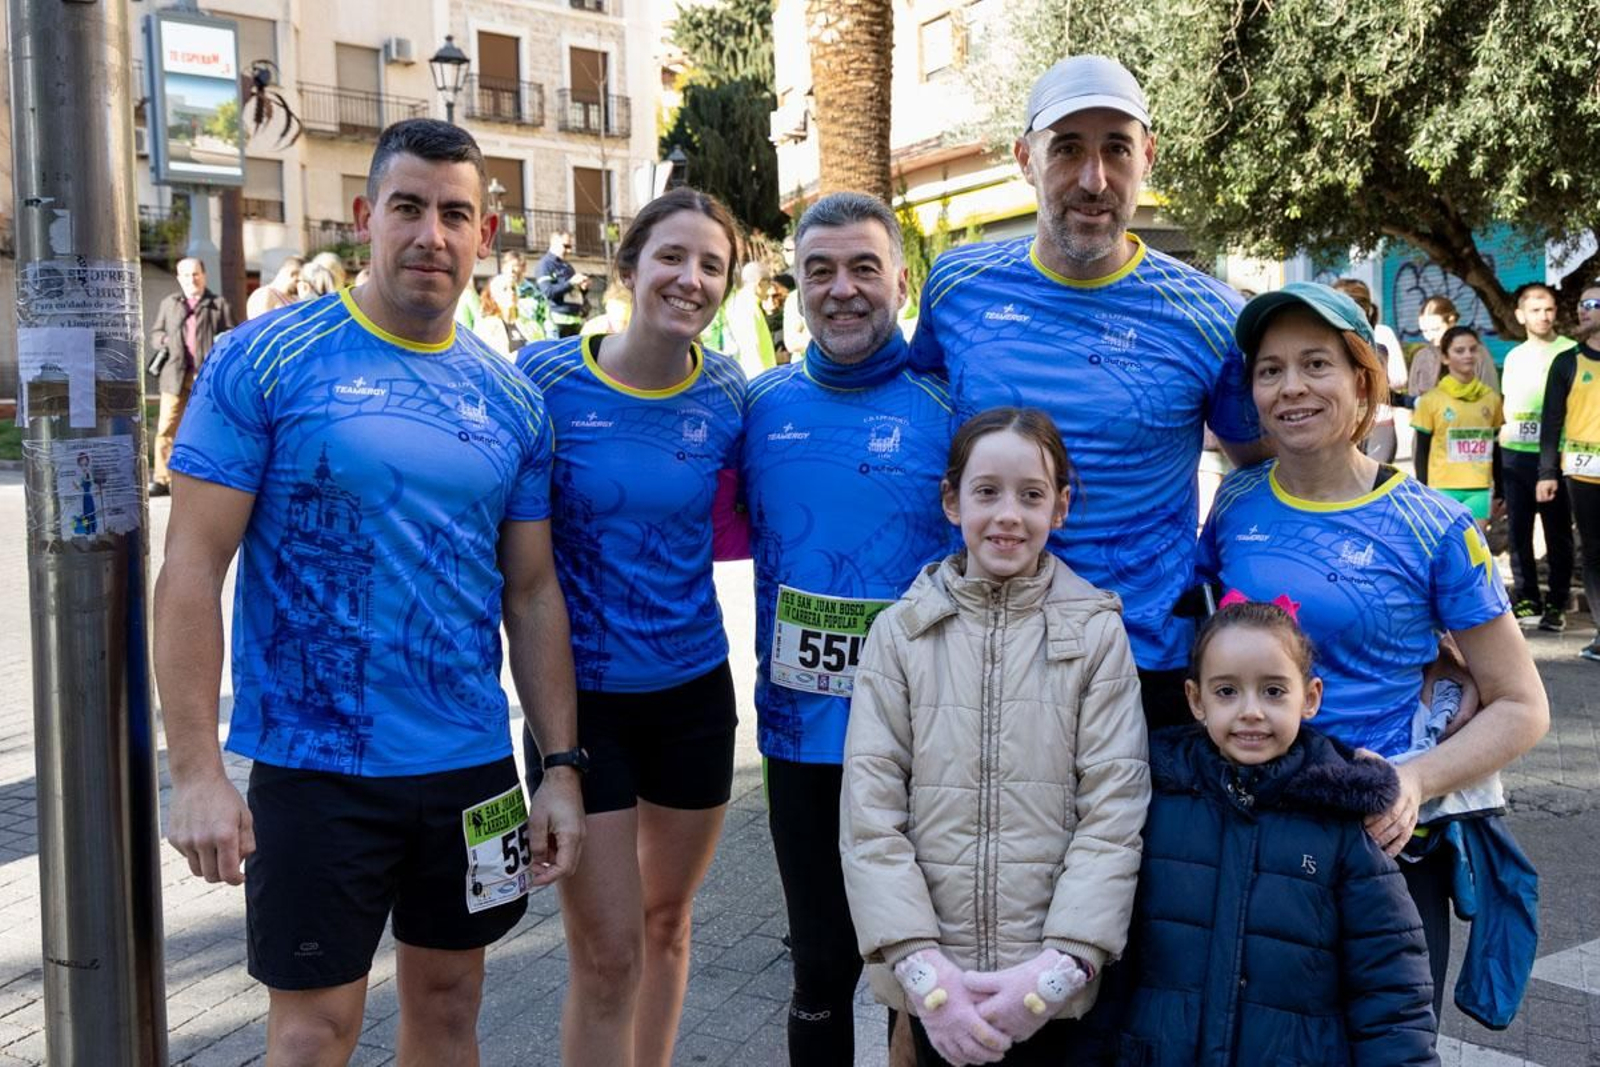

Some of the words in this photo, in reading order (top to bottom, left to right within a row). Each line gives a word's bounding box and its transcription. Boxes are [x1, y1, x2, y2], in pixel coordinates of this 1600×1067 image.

[1456, 440, 1487, 455] 1028
[797, 595, 812, 610] SAN
[814, 599, 837, 614] JUAN
[839, 603, 866, 617] BOSCO
[791, 607, 822, 628] CARRERA
[823, 613, 859, 629] POPULAR
[1301, 854, 1317, 875] FS
